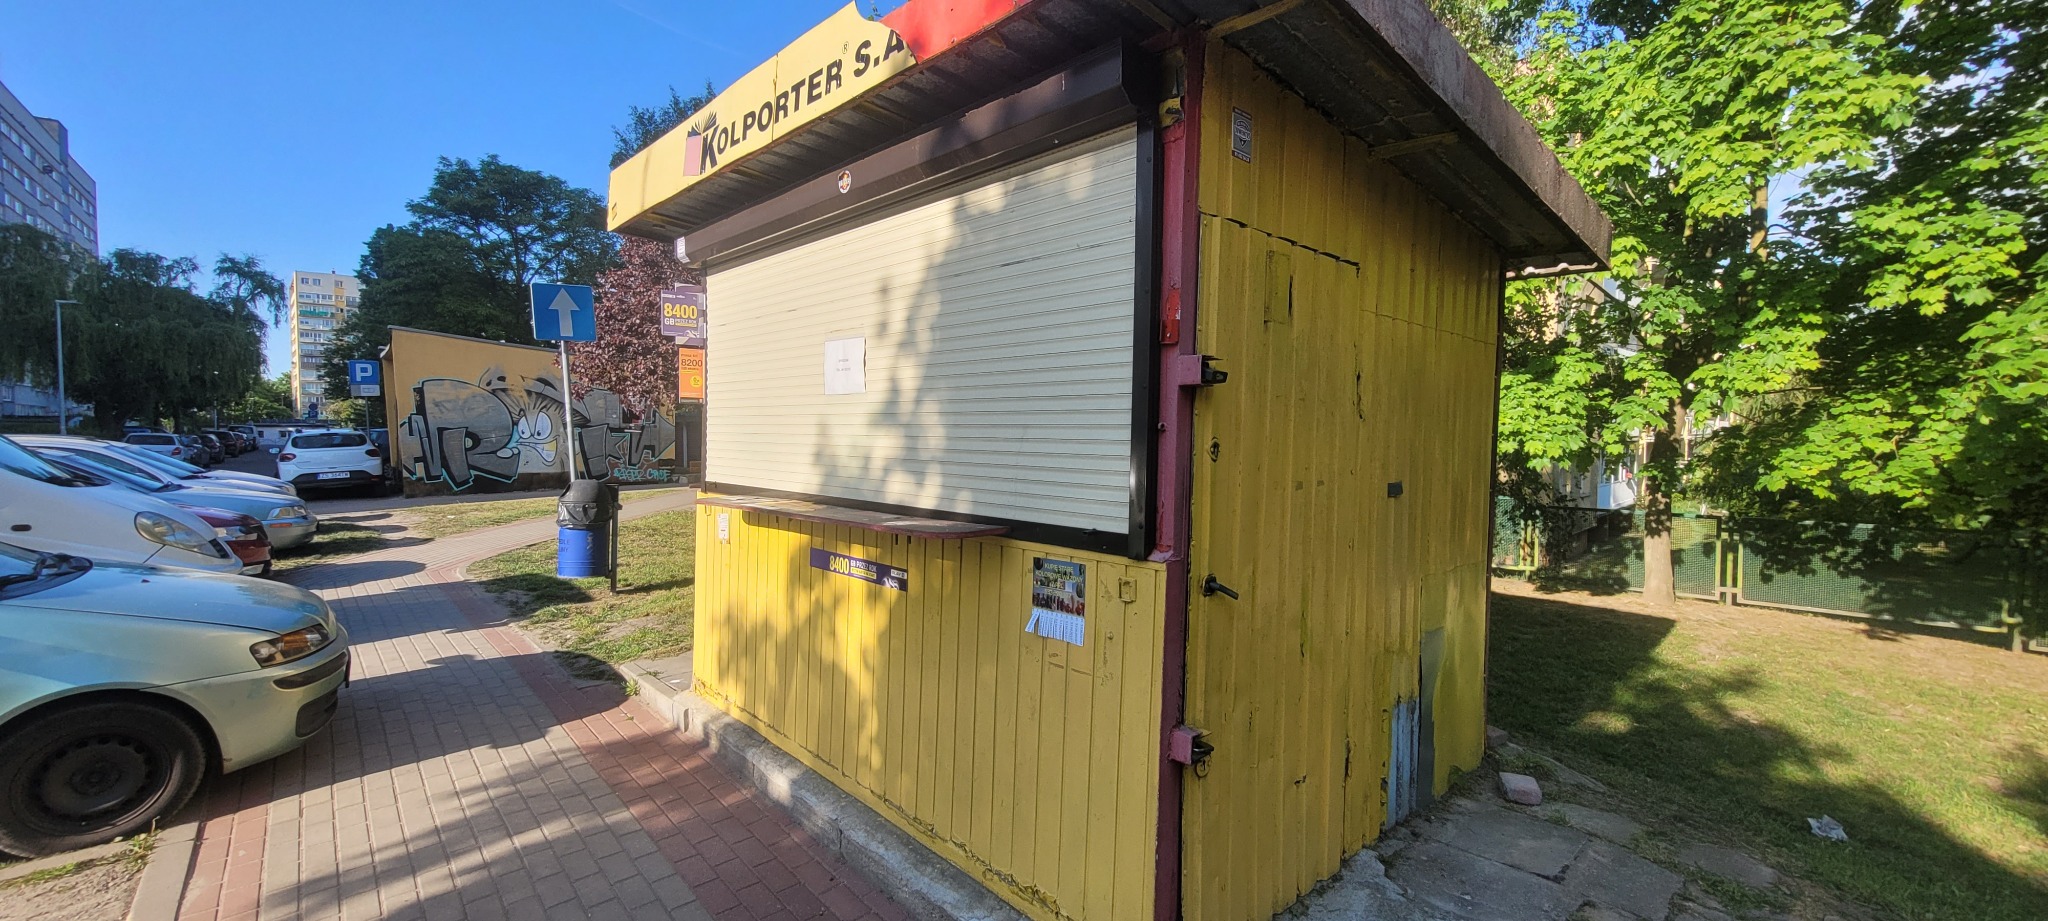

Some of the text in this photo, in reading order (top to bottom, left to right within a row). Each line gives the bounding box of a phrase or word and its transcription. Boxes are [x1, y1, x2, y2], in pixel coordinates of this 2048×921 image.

[700, 29, 913, 175] KOLPORTER S.A
[664, 303, 697, 319] 8400
[664, 317, 675, 325] GB
[680, 358, 703, 367] 8200
[355, 363, 373, 381] P
[830, 555, 849, 574] 8400
[857, 561, 868, 570] PRZEZ
[1045, 563, 1058, 572] KUPIĘ
[1035, 570, 1062, 581] KOLOROWE
